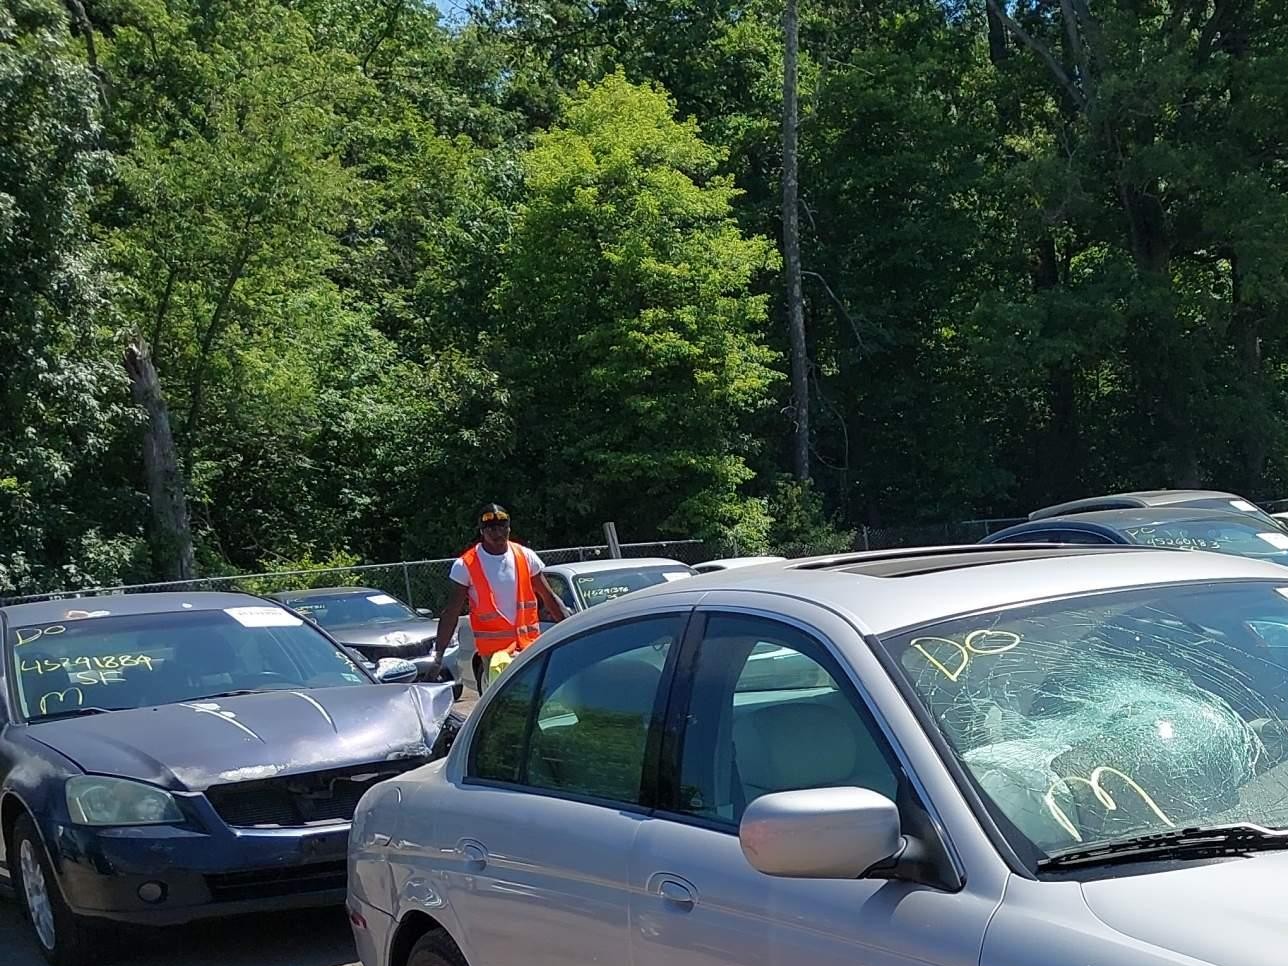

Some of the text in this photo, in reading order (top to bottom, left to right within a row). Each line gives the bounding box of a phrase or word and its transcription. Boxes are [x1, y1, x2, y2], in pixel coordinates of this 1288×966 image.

[16, 625, 67, 646] DO
[910, 629, 1021, 682] DO
[1044, 766, 1177, 842] M
